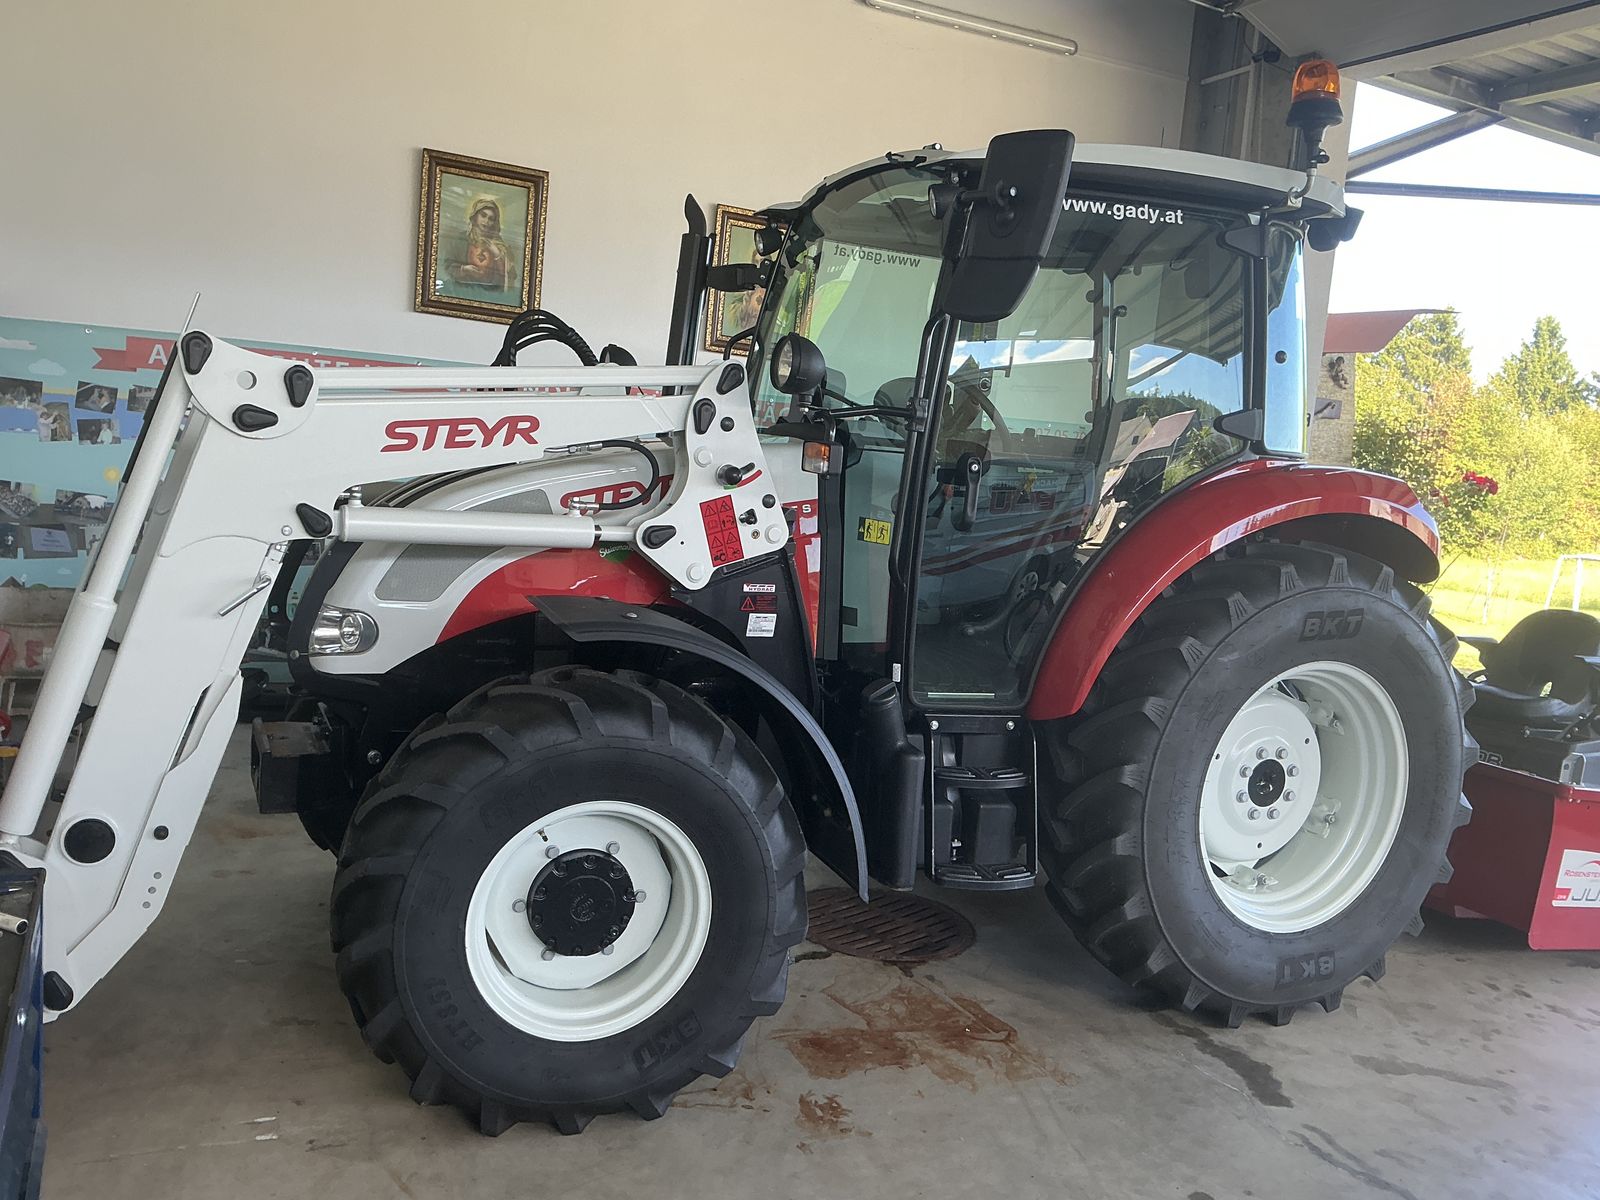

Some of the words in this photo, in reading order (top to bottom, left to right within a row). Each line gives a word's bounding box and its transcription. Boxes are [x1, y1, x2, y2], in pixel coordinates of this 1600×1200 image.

[1061, 198, 1184, 224] www.gady.at
[379, 414, 541, 453] STEYR
[1300, 611, 1364, 641] BKT
[1571, 888, 1600, 901] JU
[1276, 953, 1334, 987] BKT
[634, 1012, 703, 1070] BKT
